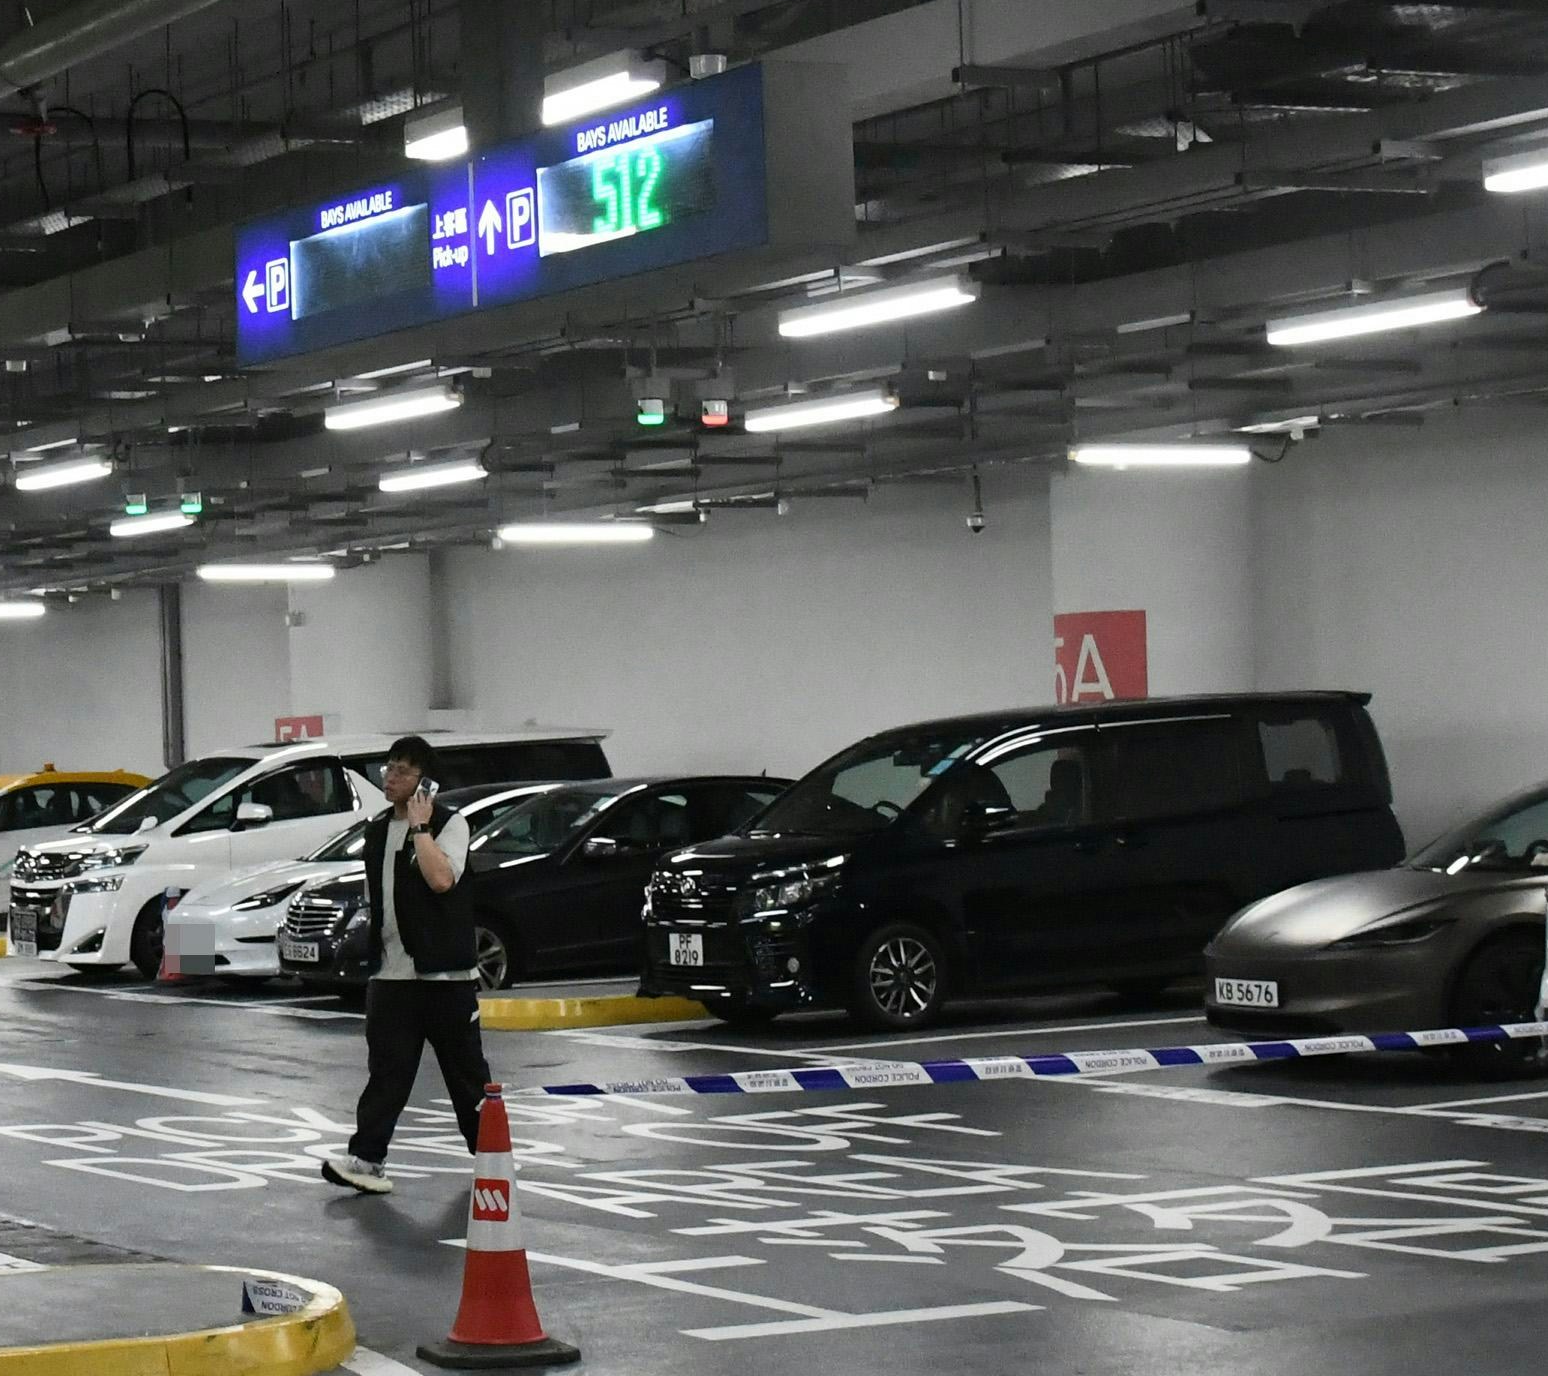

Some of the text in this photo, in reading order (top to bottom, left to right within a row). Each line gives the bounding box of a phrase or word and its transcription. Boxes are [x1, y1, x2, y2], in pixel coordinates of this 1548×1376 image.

[577, 107, 668, 152] BAYS AVAILABLE
[593, 148, 662, 232] 512
[320, 191, 393, 229] BAYS AVAILABLE
[432, 245, 469, 270] Pick-up
[674, 949, 699, 965] 8219
[678, 934, 692, 949] PF
[1218, 980, 1274, 1004] KB 5676
[854, 1071, 921, 1085] POLICE CORDON
[621, 1102, 1003, 1151] OFF
[514, 1154, 1149, 1218] AREA
